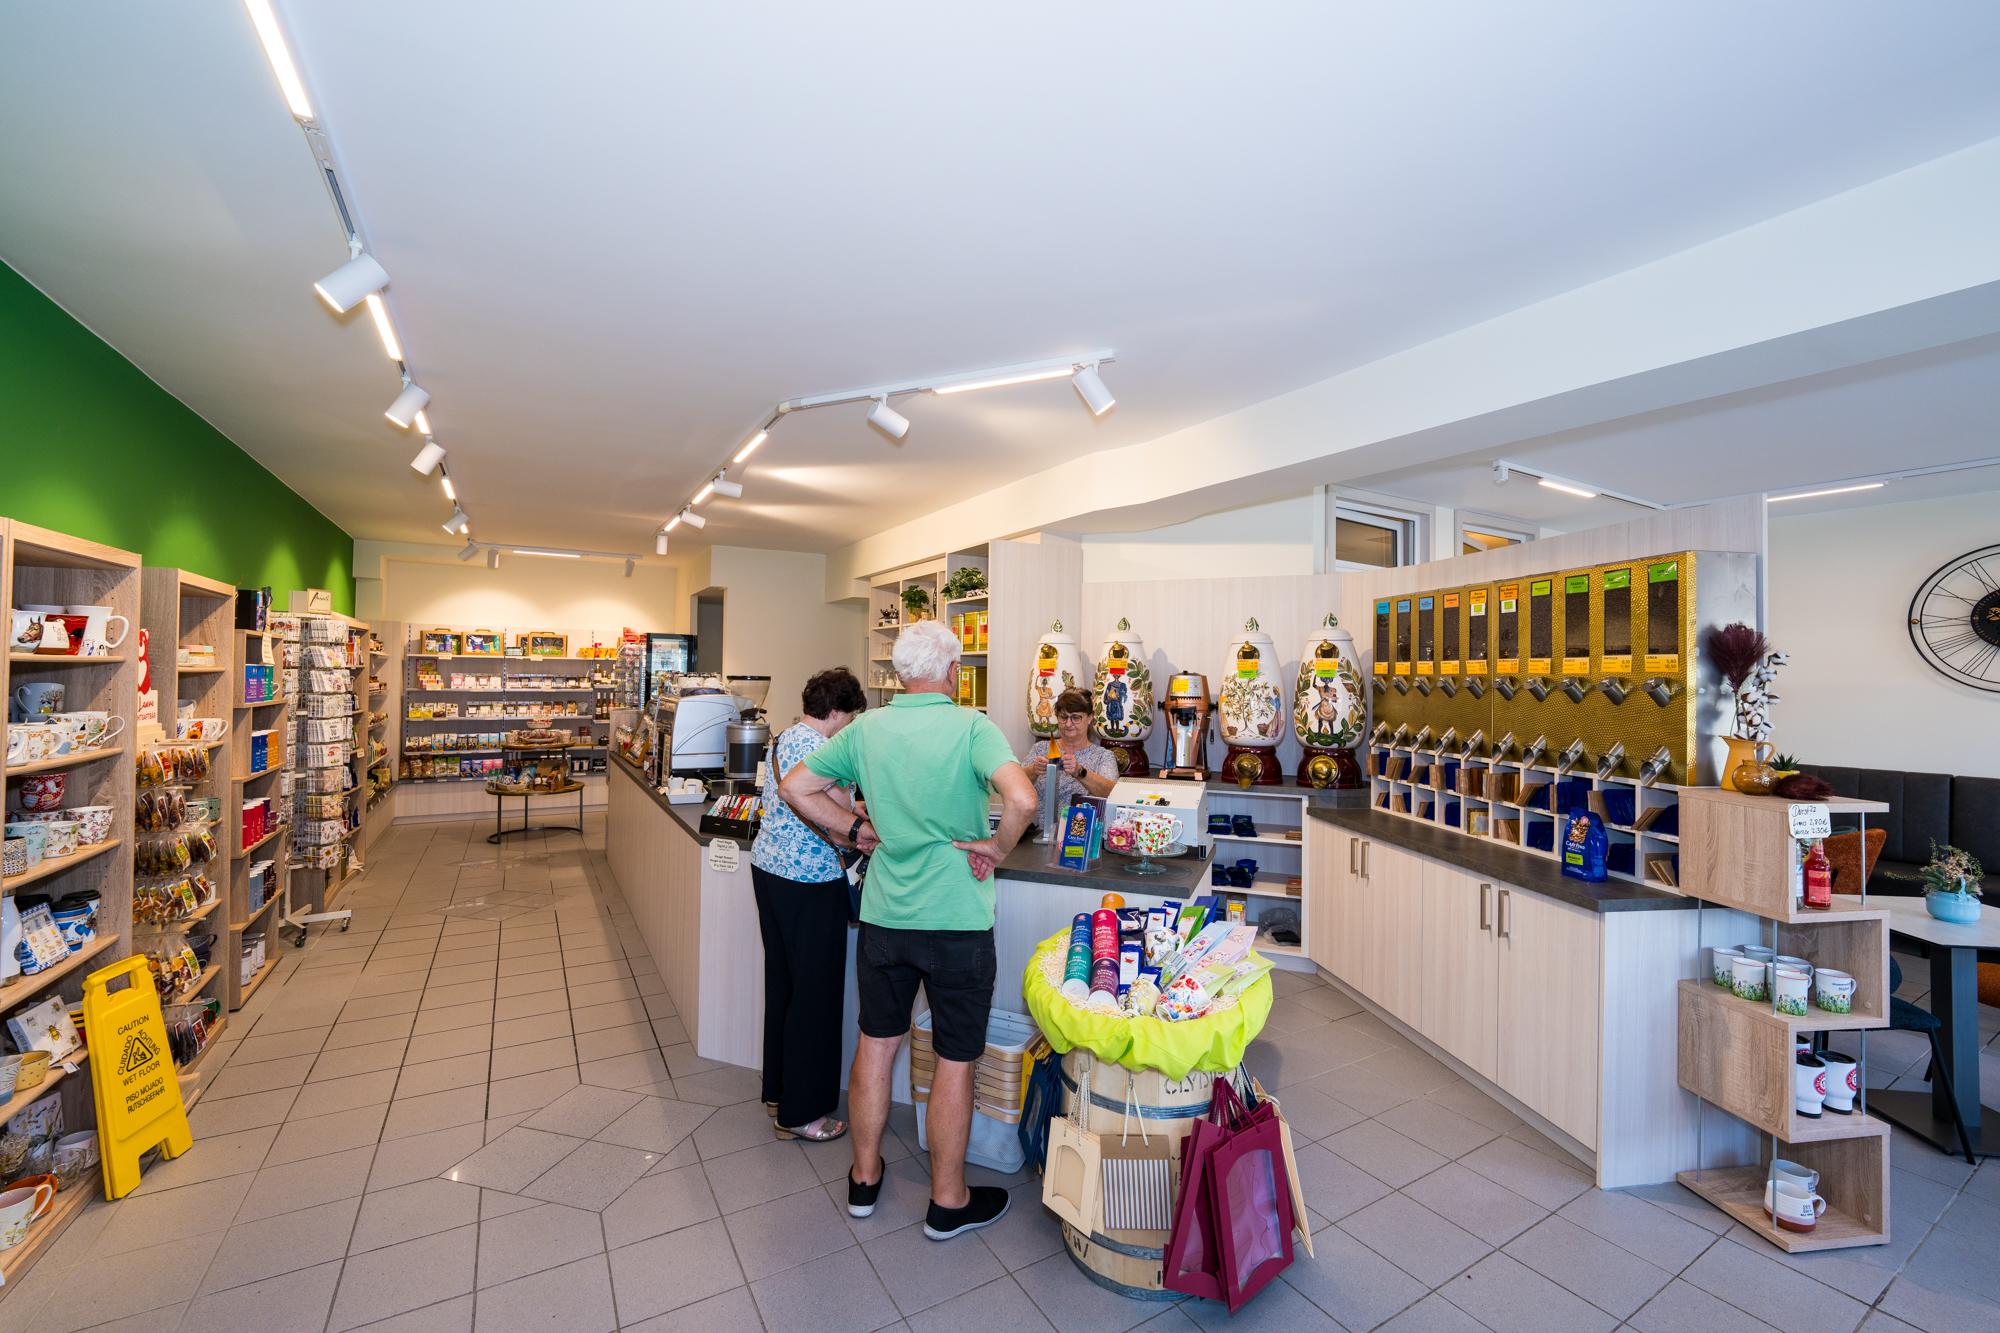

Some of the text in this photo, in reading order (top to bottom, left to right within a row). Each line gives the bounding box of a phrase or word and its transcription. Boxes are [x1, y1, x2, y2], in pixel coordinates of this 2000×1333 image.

[117, 1014, 150, 1036] CAUTION
[117, 1034, 134, 1076] CUIDADO
[137, 1029, 161, 1056] ACHTUNG
[122, 1060, 161, 1087] WET FLOOR
[125, 1076, 164, 1104] PISO MOJADO
[127, 1085, 166, 1114] RUTSCHGEFAHR
